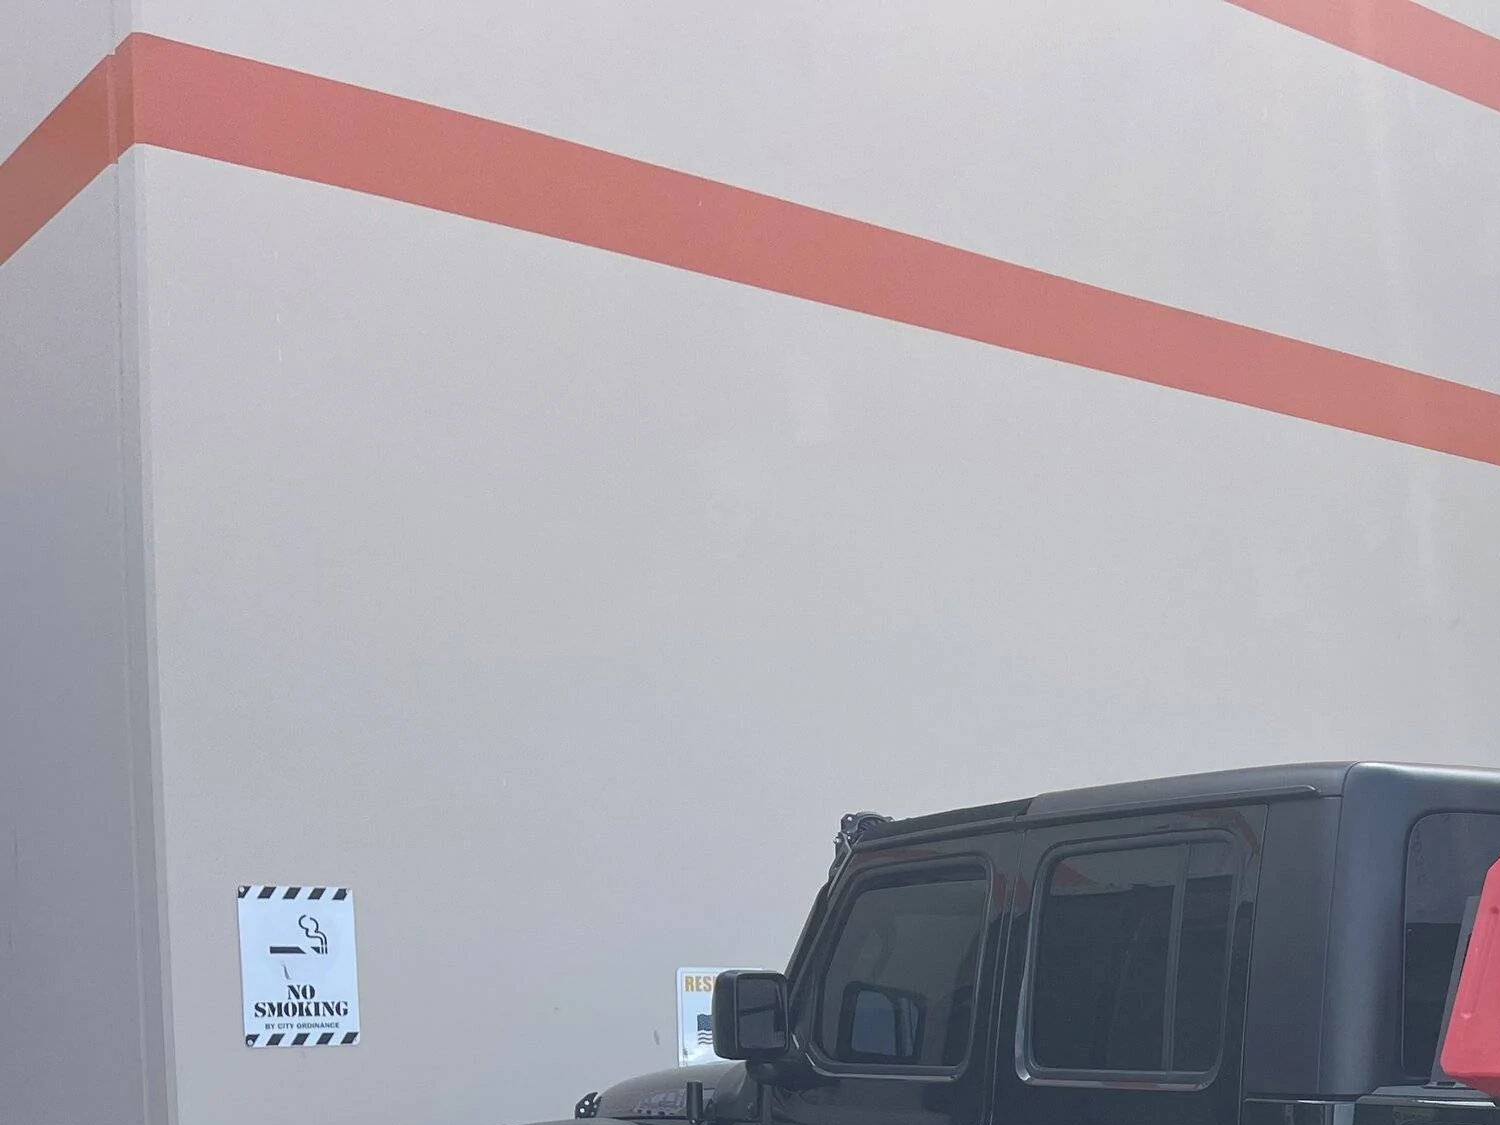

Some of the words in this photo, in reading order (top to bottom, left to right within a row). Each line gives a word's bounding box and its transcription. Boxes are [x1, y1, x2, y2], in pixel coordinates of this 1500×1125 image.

[287, 984, 316, 1000] NO
[685, 975, 716, 992] RES
[254, 1001, 349, 1018] SMOKING
